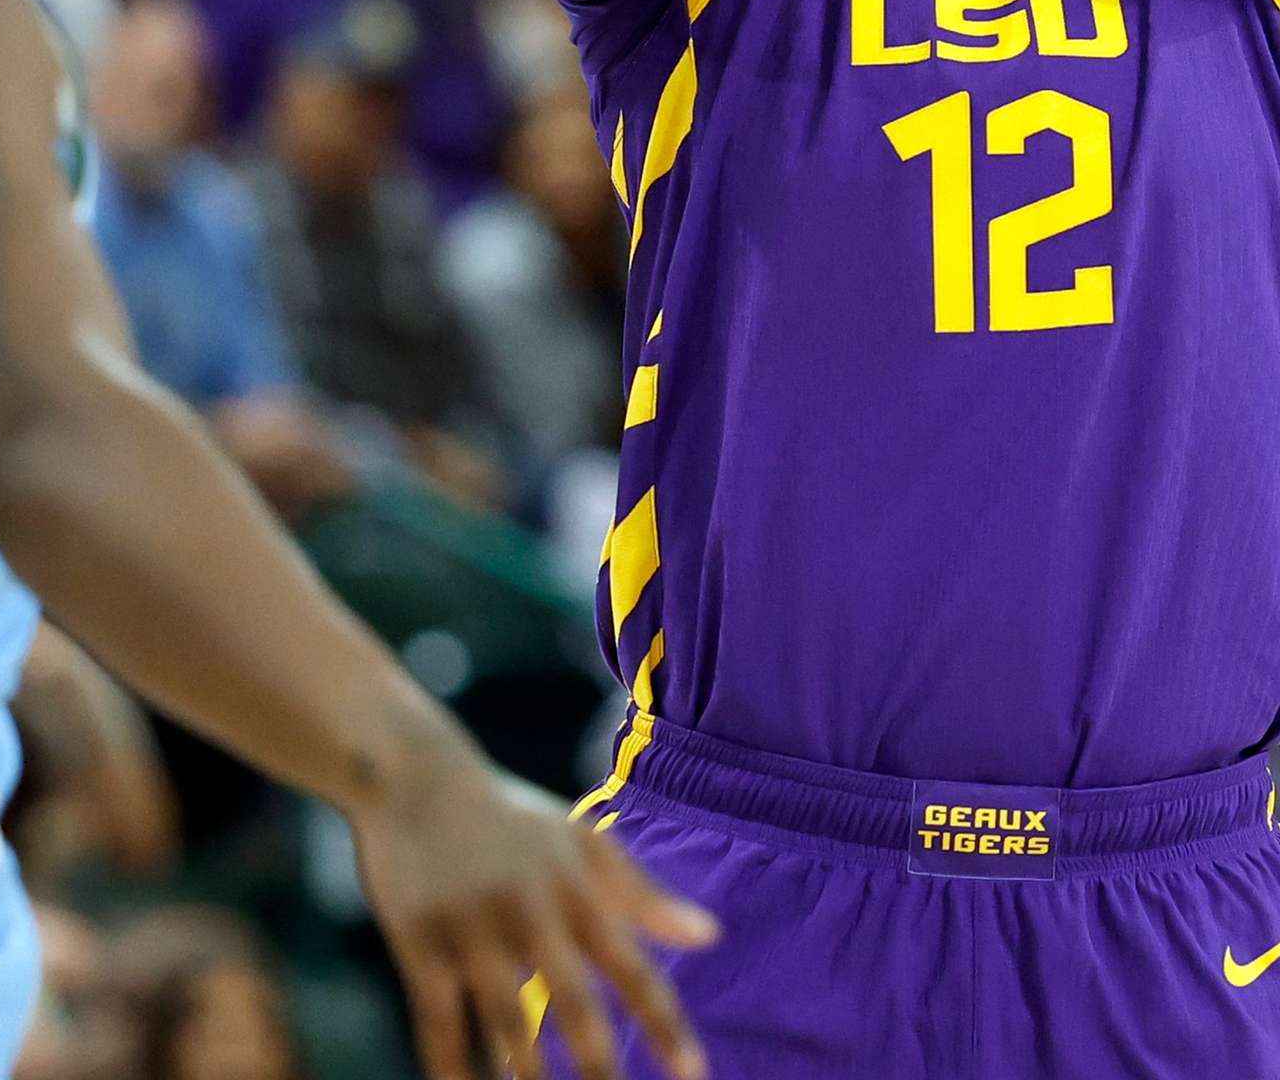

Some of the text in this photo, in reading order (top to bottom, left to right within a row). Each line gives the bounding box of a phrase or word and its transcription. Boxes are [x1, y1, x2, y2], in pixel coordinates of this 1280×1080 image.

[881, 89, 1115, 335] 12
[924, 804, 1048, 832] GEAUX
[917, 829, 1051, 856] TIGERS
